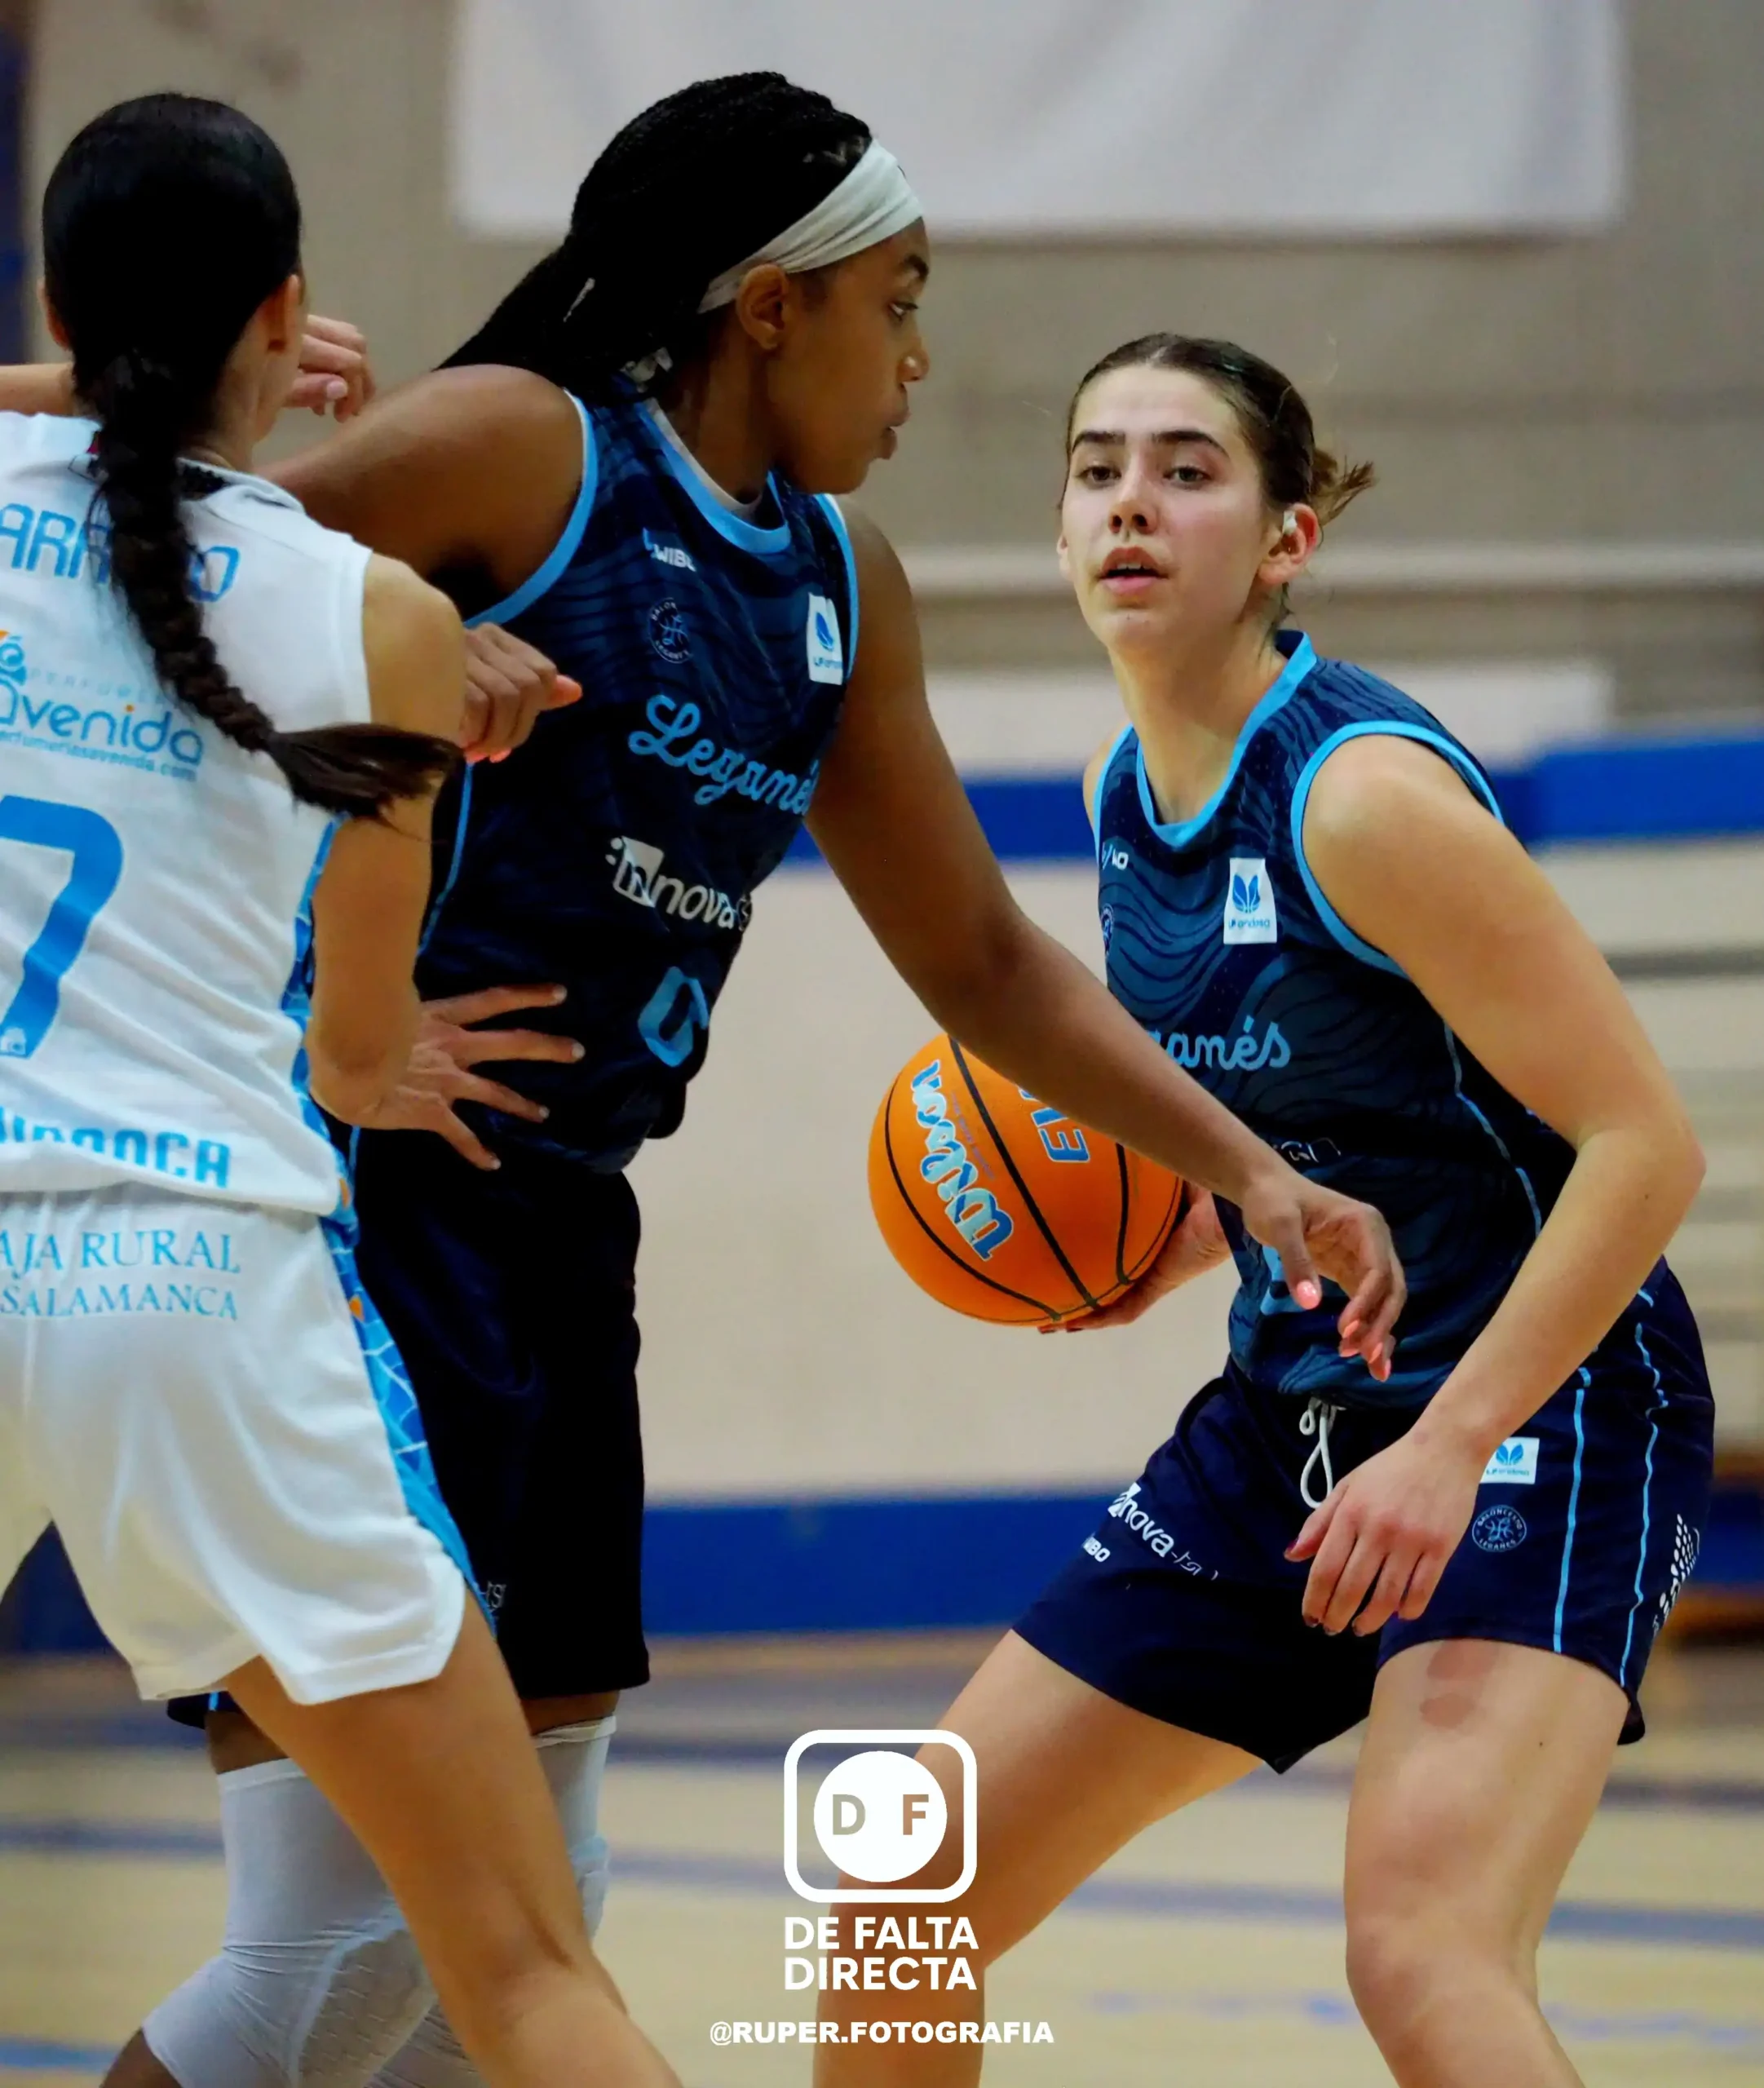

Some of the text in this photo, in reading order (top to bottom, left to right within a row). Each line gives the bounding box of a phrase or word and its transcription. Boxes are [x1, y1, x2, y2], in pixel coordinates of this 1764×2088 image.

[1148, 1015, 1292, 1072] anés
[910, 1059, 1015, 1262] Wilson
[81, 1229, 241, 1274] RURAL
